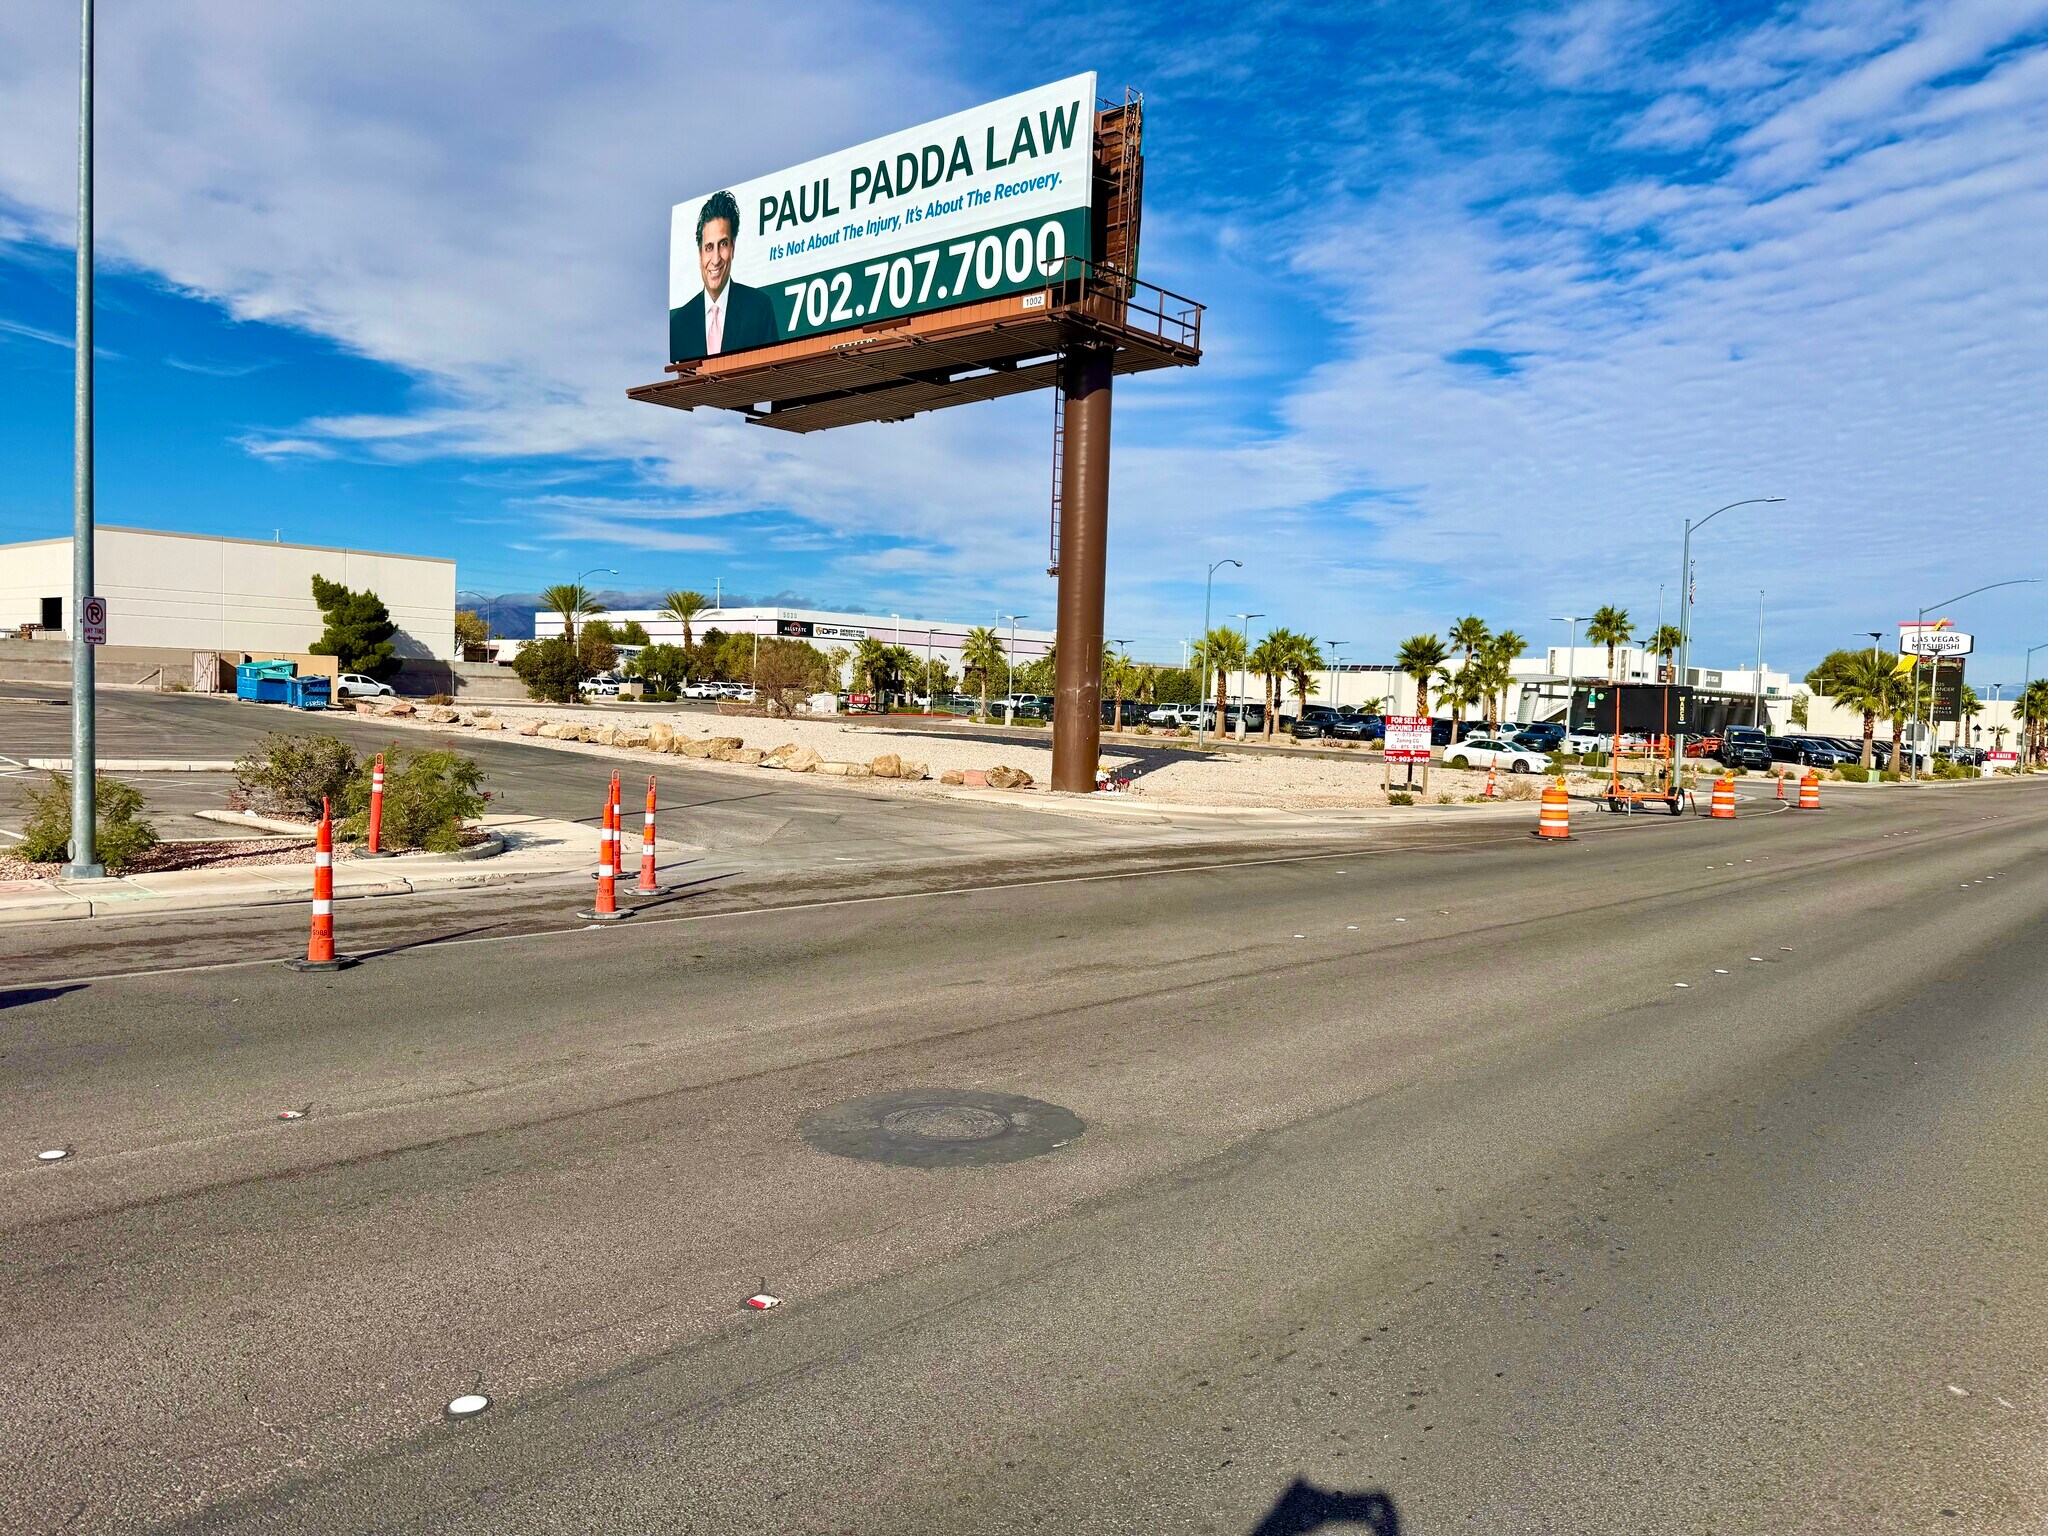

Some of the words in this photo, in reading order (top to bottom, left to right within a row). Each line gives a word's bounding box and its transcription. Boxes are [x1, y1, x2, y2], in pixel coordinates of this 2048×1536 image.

[759, 178, 840, 236] PAUL
[850, 135, 974, 210] PADDA
[986, 100, 1080, 171] LAW
[769, 244, 784, 261] It's
[786, 240, 805, 257] Not
[807, 229, 840, 251] About
[843, 223, 864, 241] The
[866, 214, 902, 237] Injury,
[905, 205, 922, 225] It's
[925, 195, 964, 219] About
[967, 188, 991, 209] The
[994, 172, 1063, 201] Recovery.
[784, 220, 1066, 332] 702.707.7000
[1026, 296, 1043, 306] 1002
